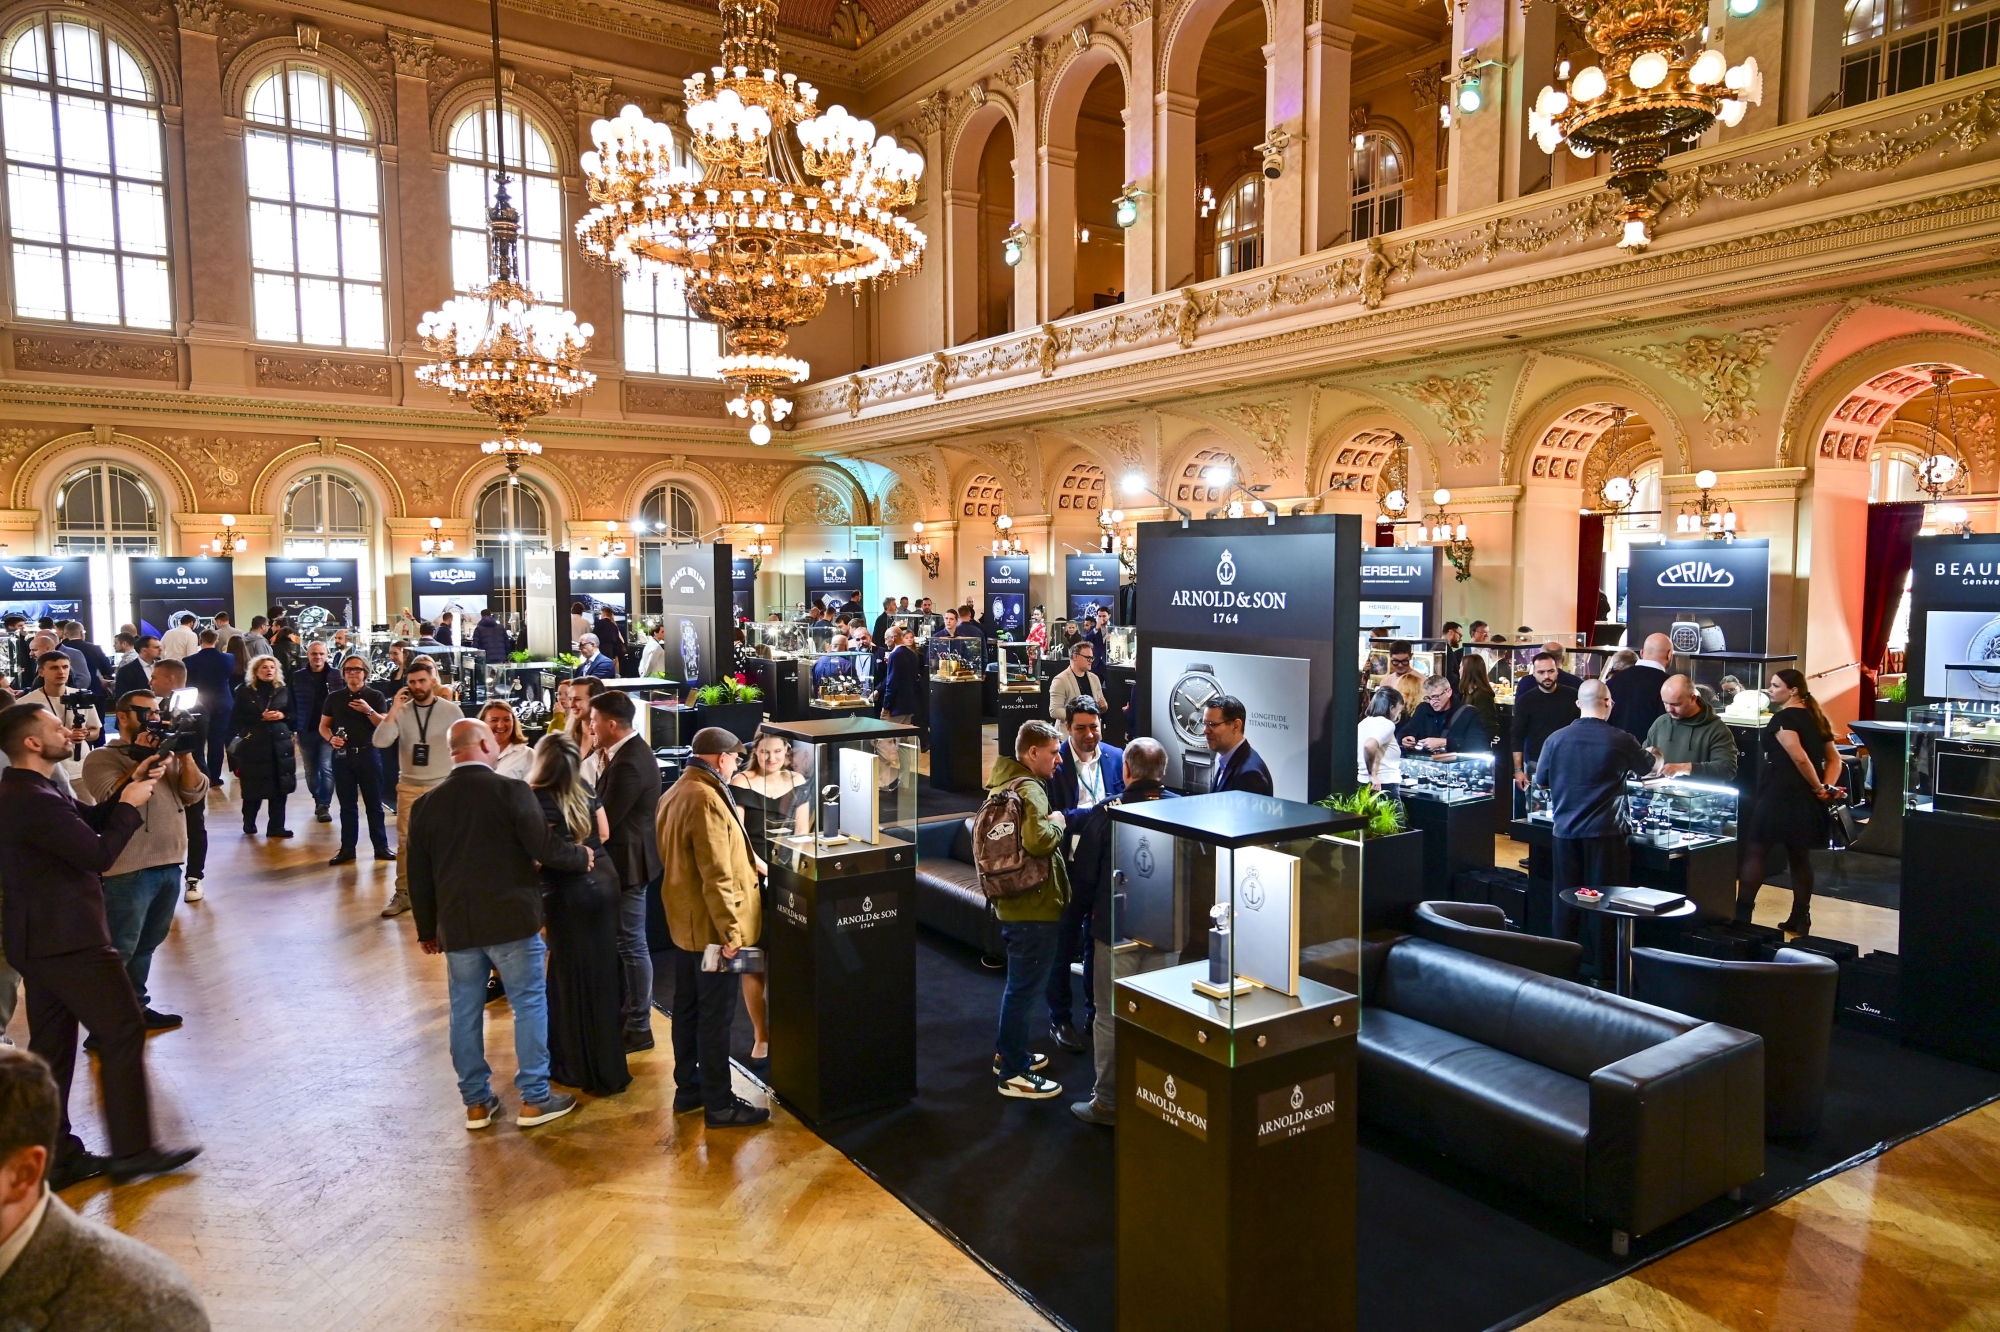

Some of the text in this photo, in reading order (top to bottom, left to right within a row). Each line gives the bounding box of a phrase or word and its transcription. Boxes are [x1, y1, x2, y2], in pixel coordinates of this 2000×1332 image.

[429, 568, 476, 580] VULCAIN
[822, 566, 847, 577] 150
[1665, 561, 1726, 583] PRIM
[12, 581, 57, 589] AVIATOR
[155, 577, 208, 585] BEAUBLEU
[1213, 613, 1239, 624] 1764
[1251, 711, 1287, 723] LONGITUDE
[1248, 719, 1277, 730] TITANIUM
[860, 922, 875, 930] 1764
[1855, 1002, 1881, 1015] Sinn
[1162, 1112, 1179, 1128] 1764
[1288, 1124, 1306, 1137] 1764
